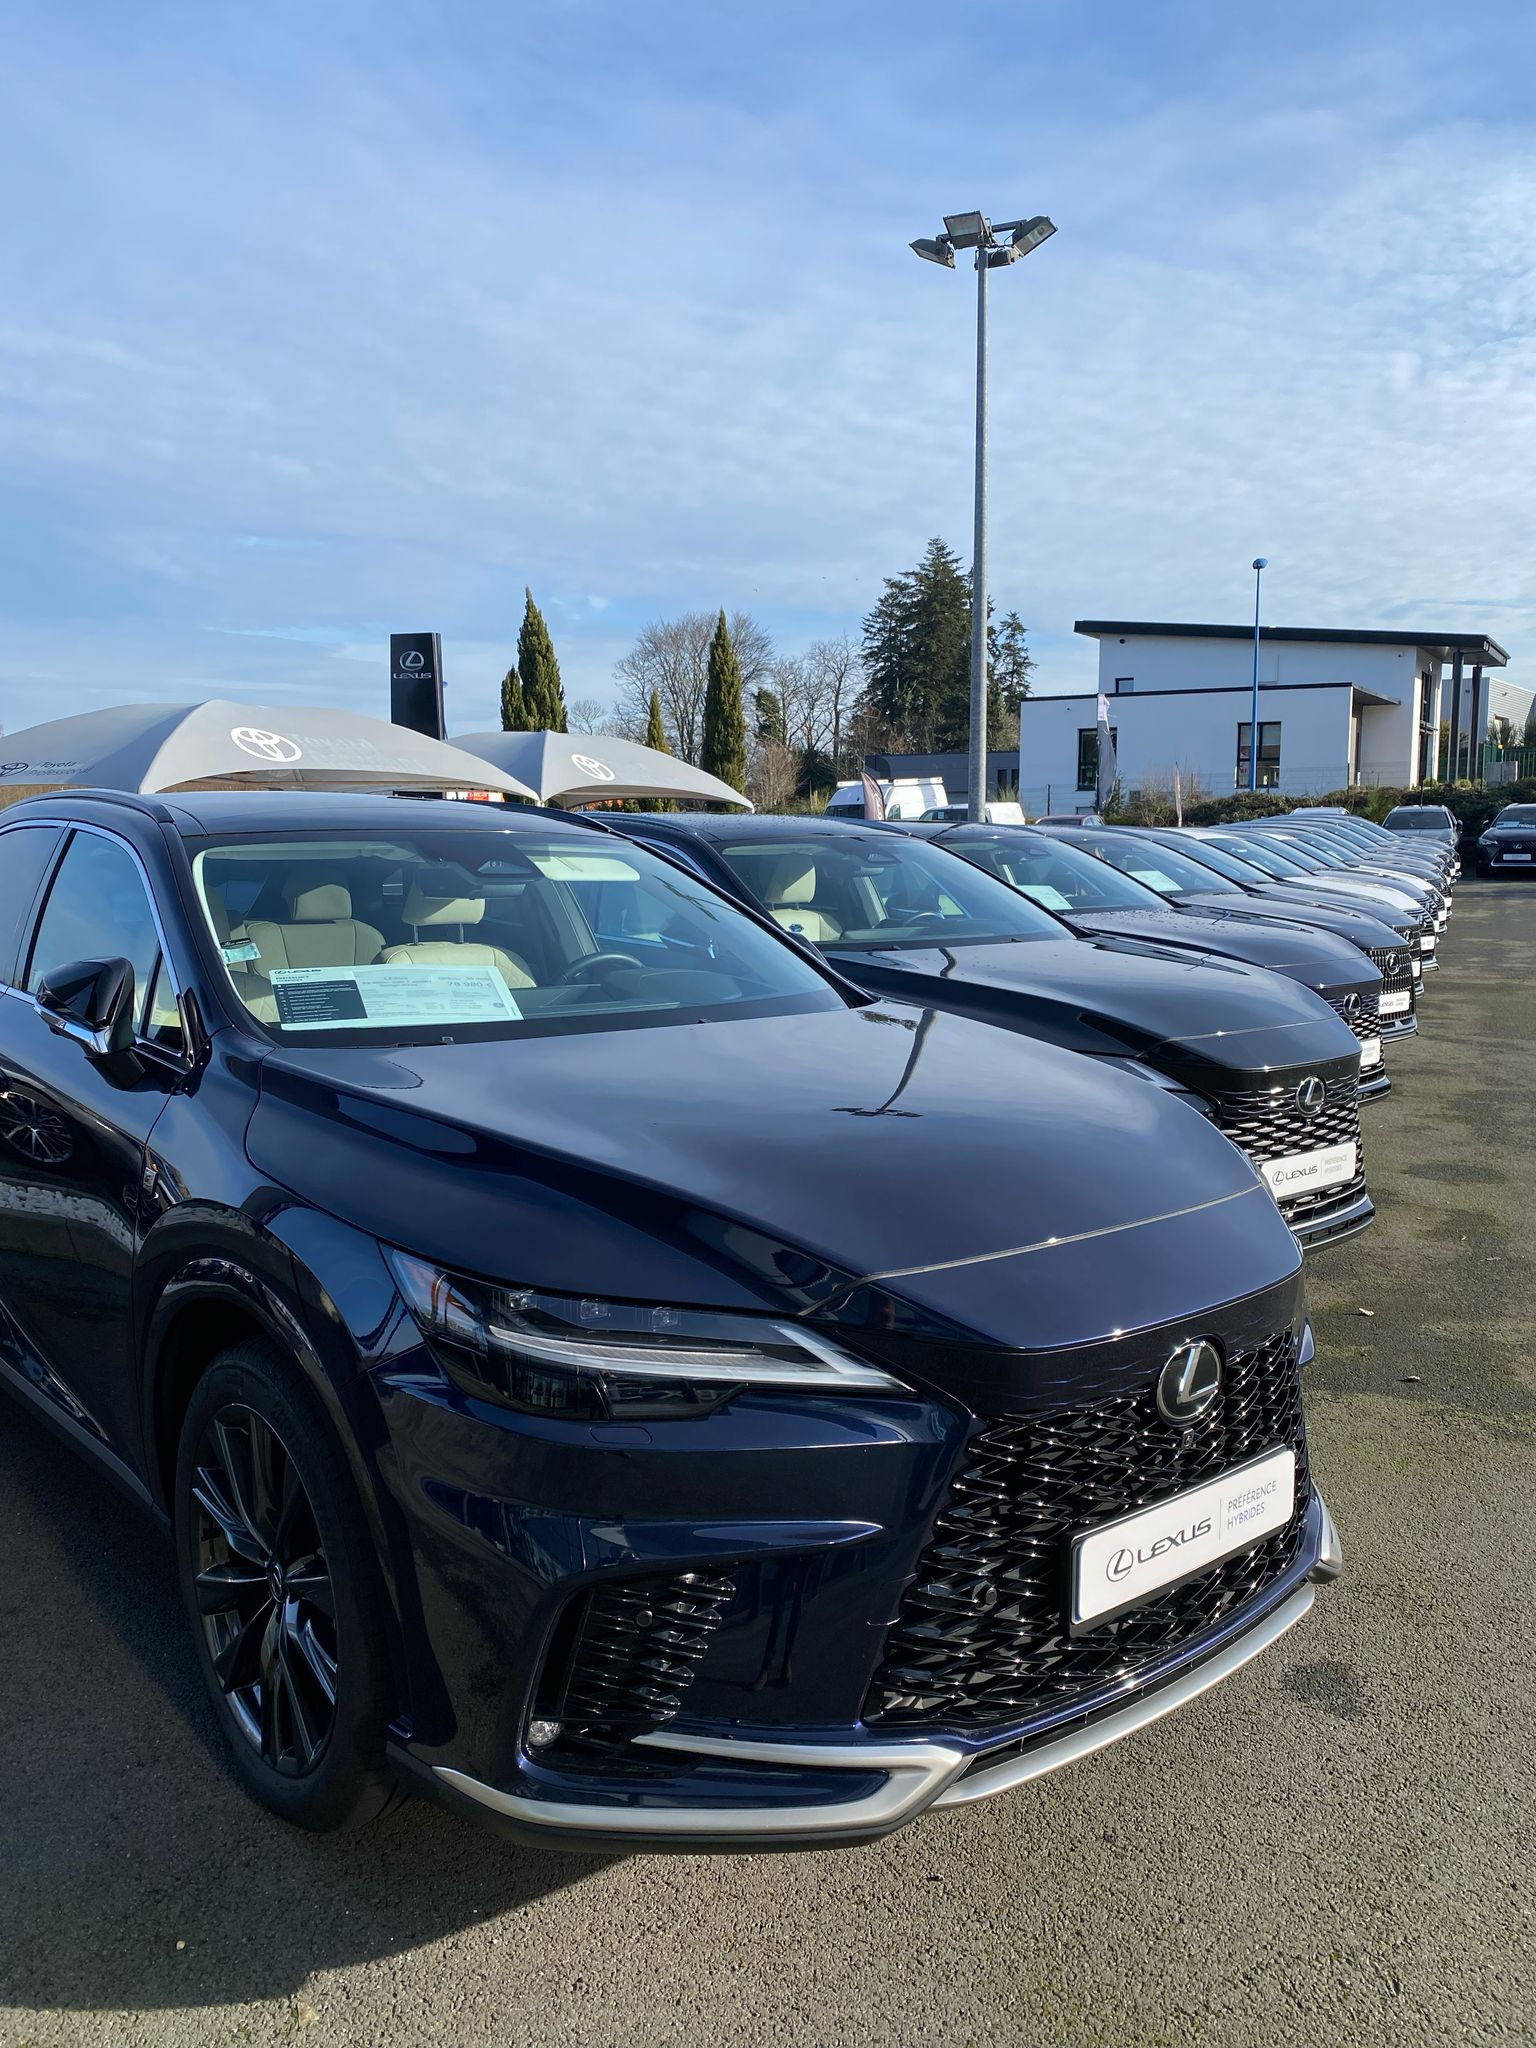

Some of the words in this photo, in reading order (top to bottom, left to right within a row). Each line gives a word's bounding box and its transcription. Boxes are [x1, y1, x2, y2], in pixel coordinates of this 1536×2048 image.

[1285, 1165, 1318, 1181] LEXUS
[1227, 1480, 1277, 1513] PRÉFÉRENCE
[1227, 1502, 1265, 1530] HYBRIDES
[1137, 1517, 1212, 1564] LEXUS
